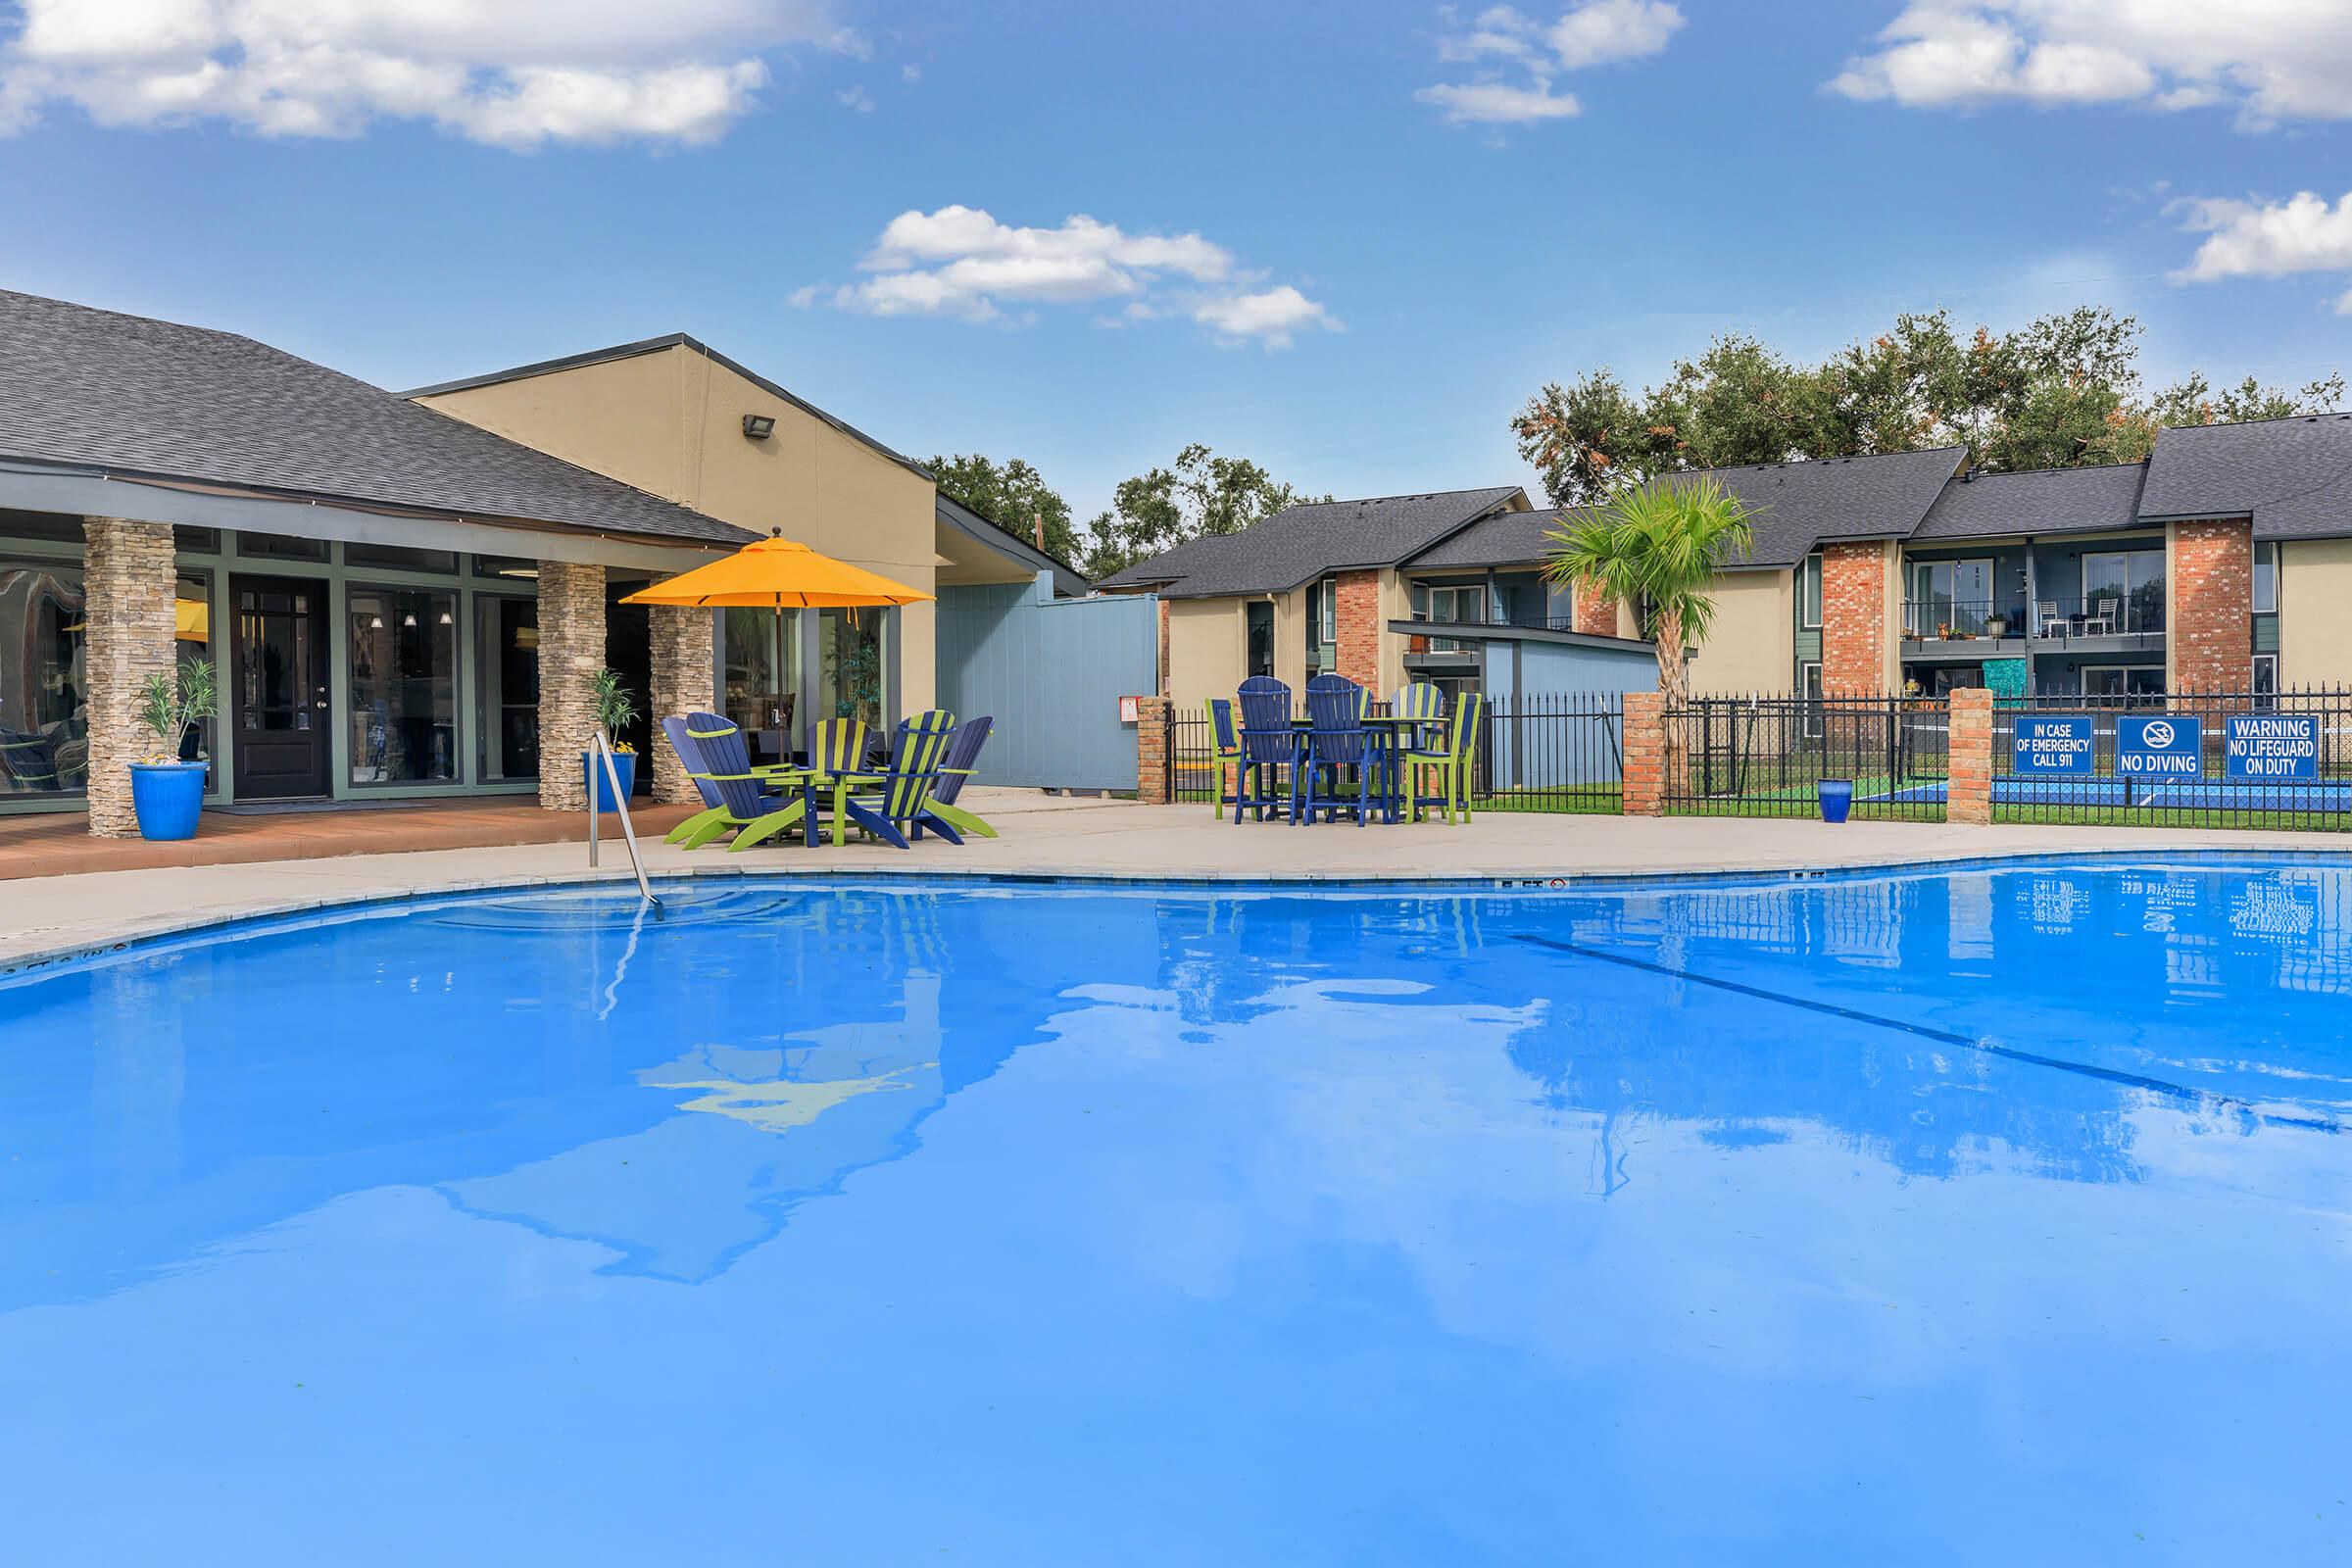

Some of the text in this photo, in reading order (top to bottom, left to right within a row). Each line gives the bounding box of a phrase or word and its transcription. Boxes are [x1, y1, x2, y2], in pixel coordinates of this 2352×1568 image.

[2034, 724, 2072, 737] IN CASE
[2234, 720, 2310, 737] WARNING
[2017, 739, 2090, 752] OF EMERGENCY
[2230, 740, 2314, 758] NO LIFEGUARD
[2033, 754, 2073, 767] CALL 911
[2121, 755, 2196, 772] NO DIVING
[2245, 758, 2297, 775] ON DUTY
